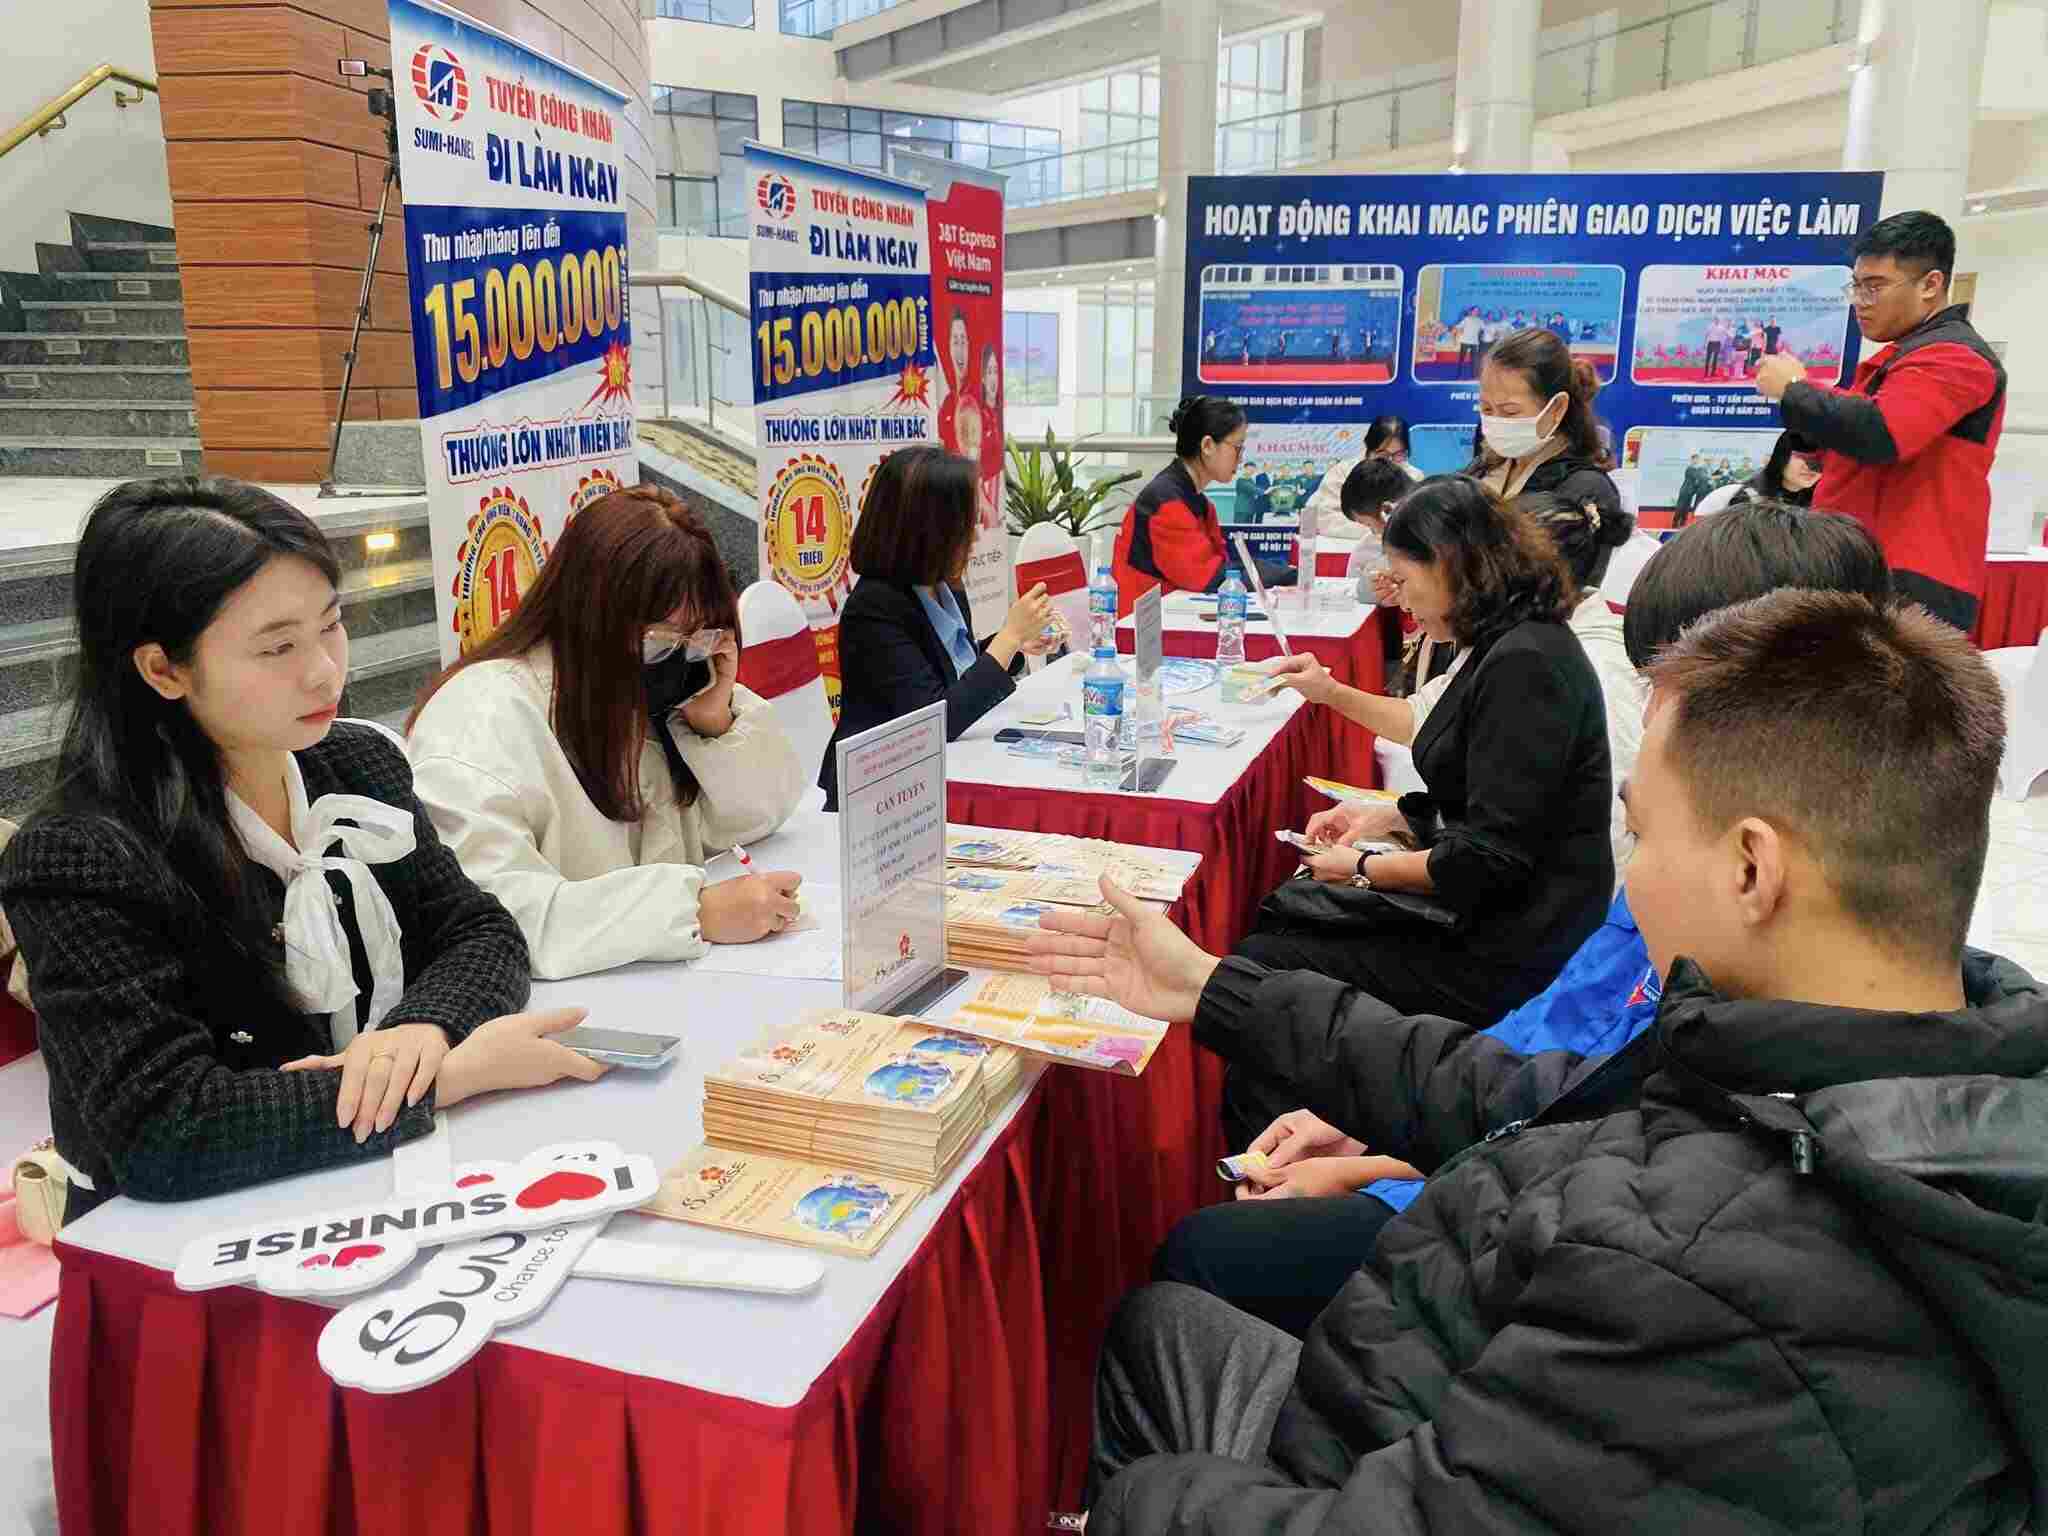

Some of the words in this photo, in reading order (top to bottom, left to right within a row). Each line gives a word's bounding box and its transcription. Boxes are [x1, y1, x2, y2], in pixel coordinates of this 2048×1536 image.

[540, 92, 579, 133] CÔNG
[414, 127, 475, 160] SUMI-HANEL
[486, 132, 513, 185] ĐI
[517, 129, 564, 194] LÀM
[568, 153, 618, 205] NGAY
[959, 225, 997, 250] Express
[1204, 203, 1273, 243] HOẠT
[1277, 197, 1352, 243] ĐỘNG
[1357, 203, 1420, 236] KHAI
[1427, 203, 1489, 242] MẠC
[1496, 197, 1579, 236] PHIÊN
[1585, 203, 1649, 236] GIAO
[1656, 203, 1723, 242] DỊCH
[1730, 197, 1792, 243] VIỆC
[1796, 198, 1861, 236] LÀM
[423, 232, 450, 264] Thu
[453, 226, 519, 263] nhập/tháng
[810, 224, 831, 257] ĐI
[835, 220, 872, 263] LÀM
[876, 236, 918, 269] NGAY
[967, 252, 992, 273] Nam
[1704, 267, 1750, 280] KHAI
[1754, 267, 1792, 282] MẠC
[758, 289, 775, 308] Thu
[788, 495, 827, 545] 14
[613, 1166, 634, 1191] I
[213, 1192, 508, 1267] SUNRISE
[493, 1245, 550, 1303] Chance
[543, 1226, 569, 1258] to
